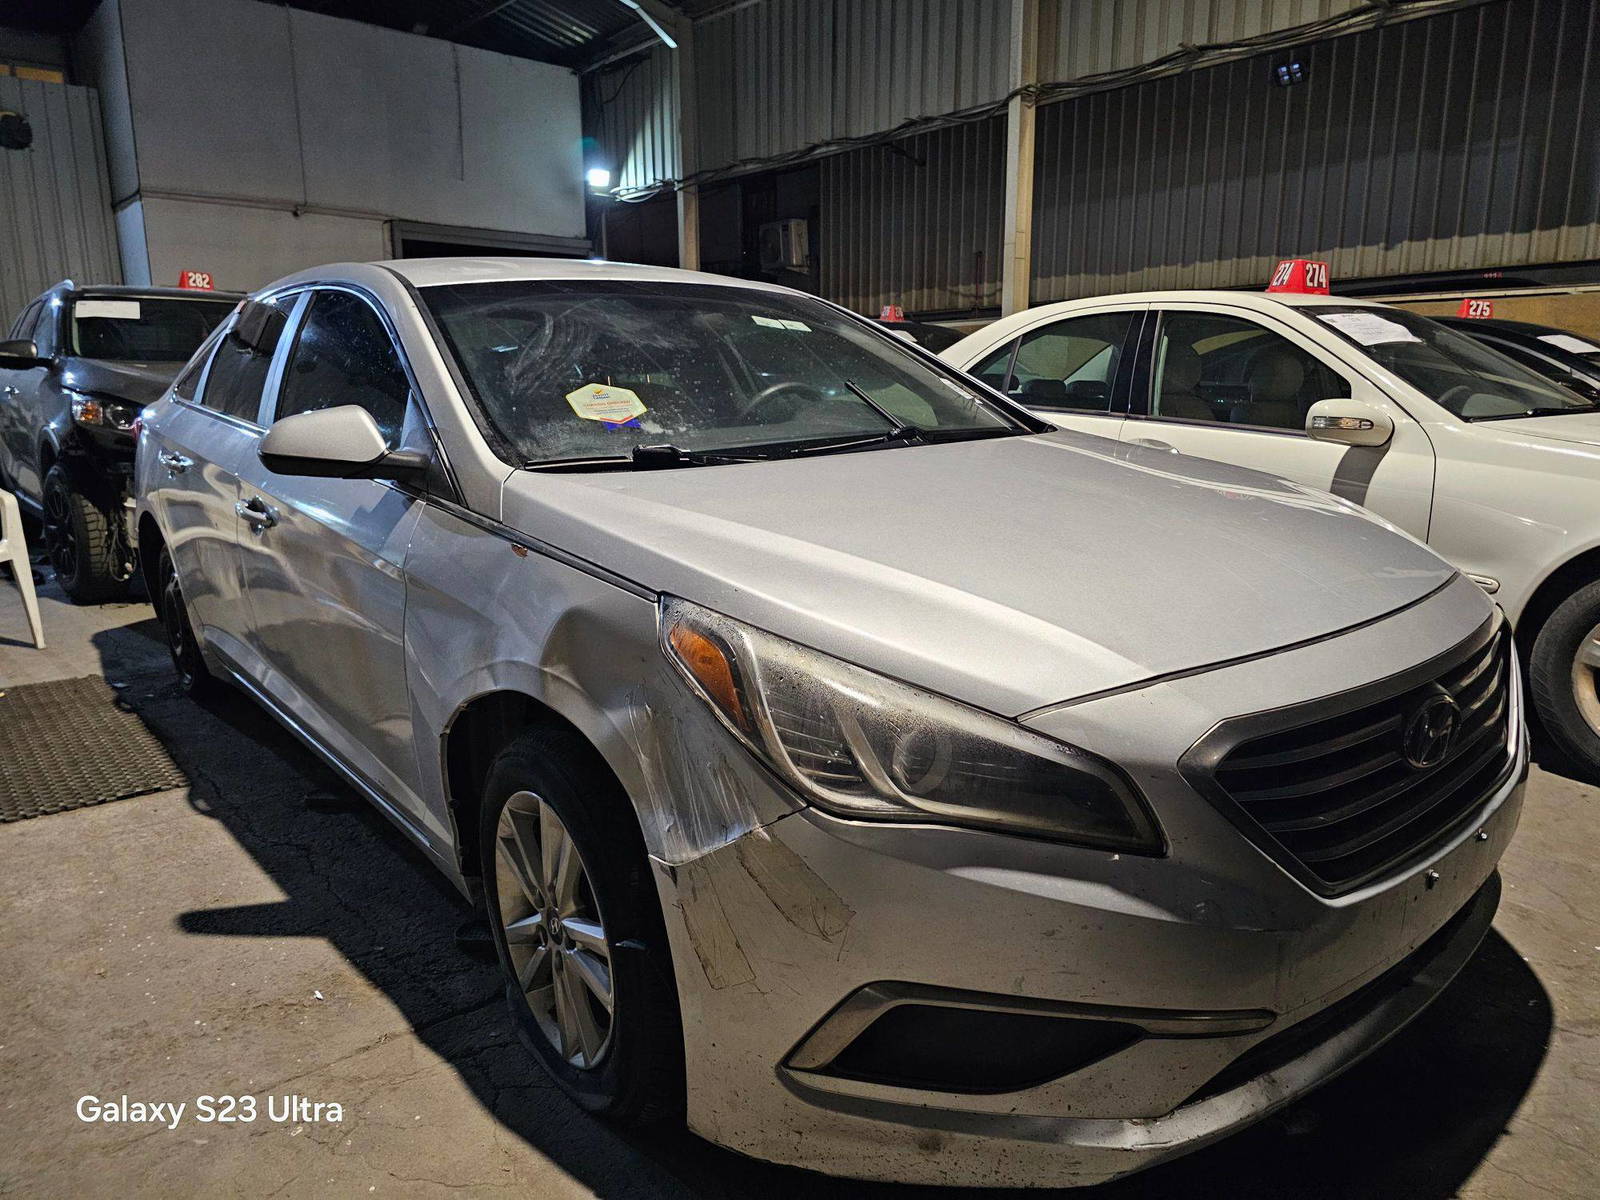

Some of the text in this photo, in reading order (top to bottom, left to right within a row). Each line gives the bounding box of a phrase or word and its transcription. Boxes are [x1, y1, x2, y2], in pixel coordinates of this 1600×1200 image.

[188, 272, 210, 288] 282
[1272, 262, 1295, 286] 274
[1305, 263, 1326, 288] 274
[1469, 300, 1490, 316] 275
